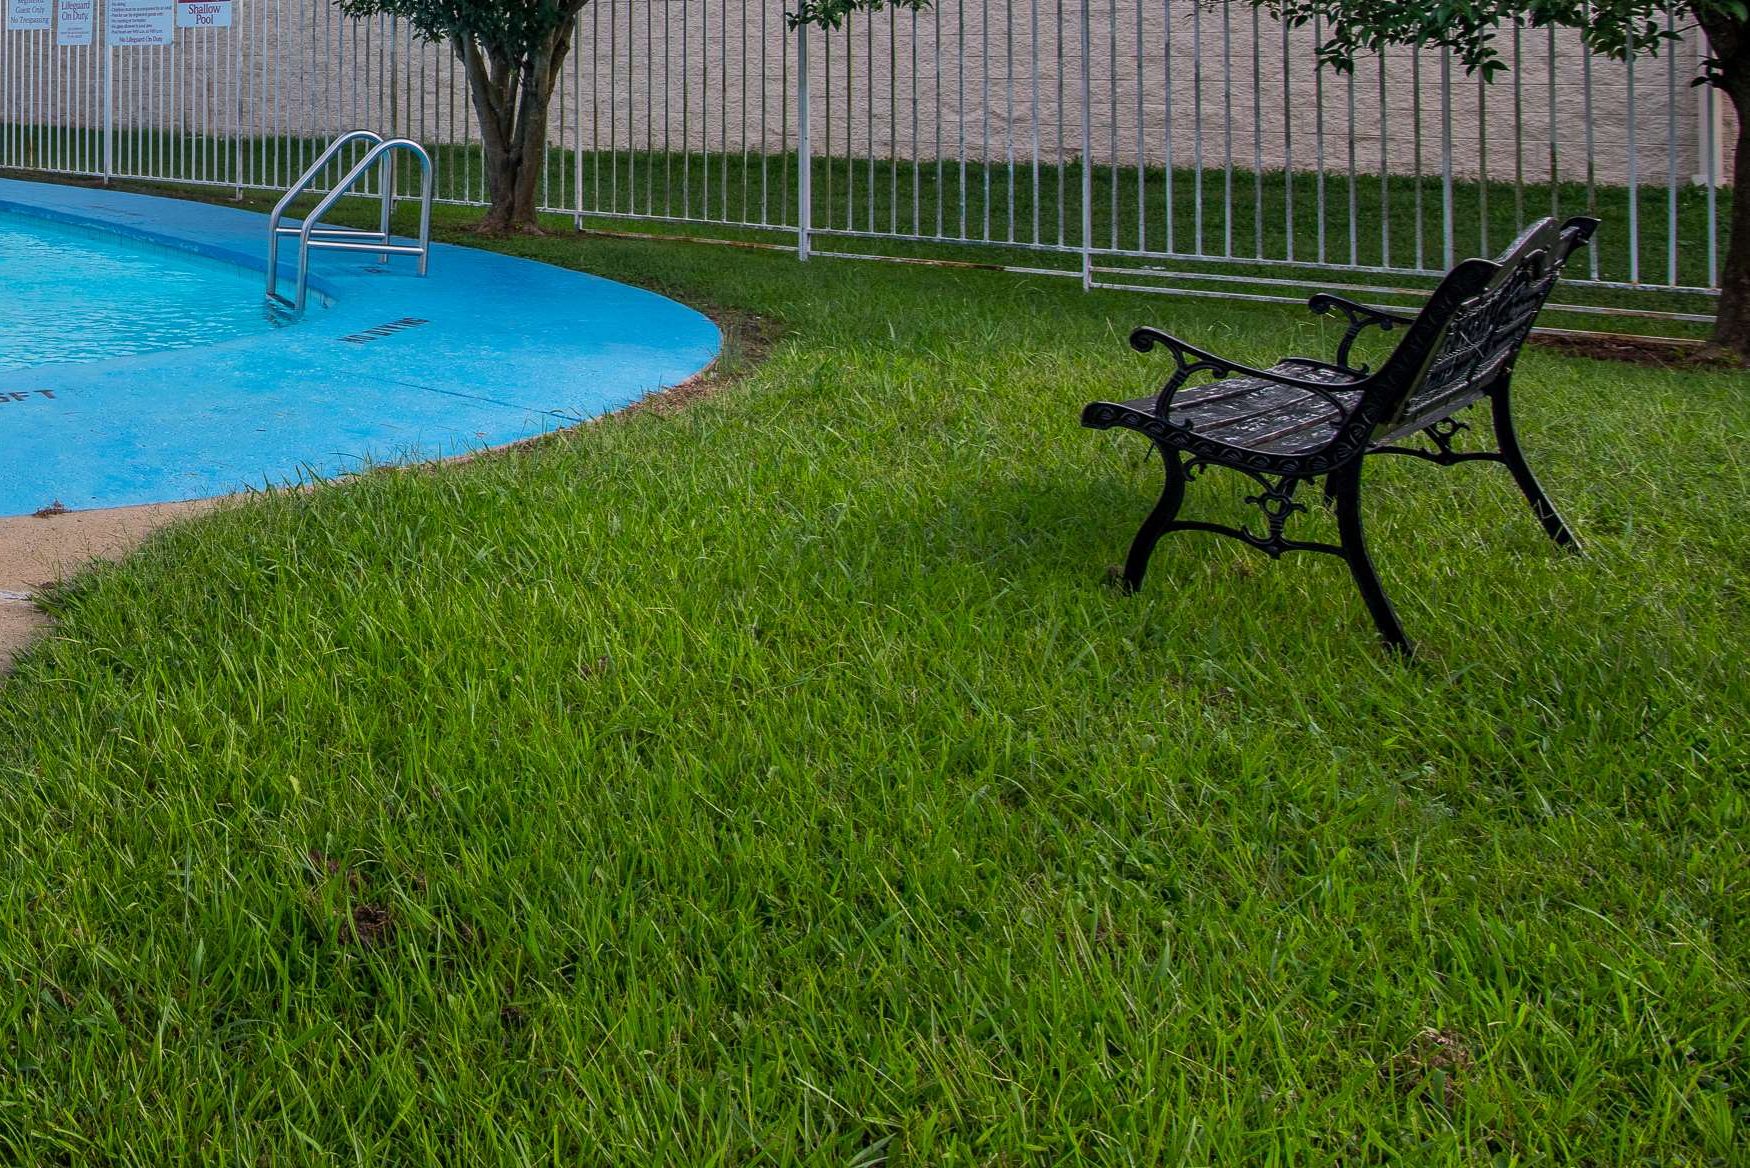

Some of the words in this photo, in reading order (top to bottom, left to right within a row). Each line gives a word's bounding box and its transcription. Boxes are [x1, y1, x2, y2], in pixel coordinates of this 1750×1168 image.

[32, 6, 45, 15] Only
[61, 1, 90, 12] Lifeguard
[188, 4, 221, 15] Shallow
[61, 12, 72, 21] On
[196, 15, 214, 25] Pool
